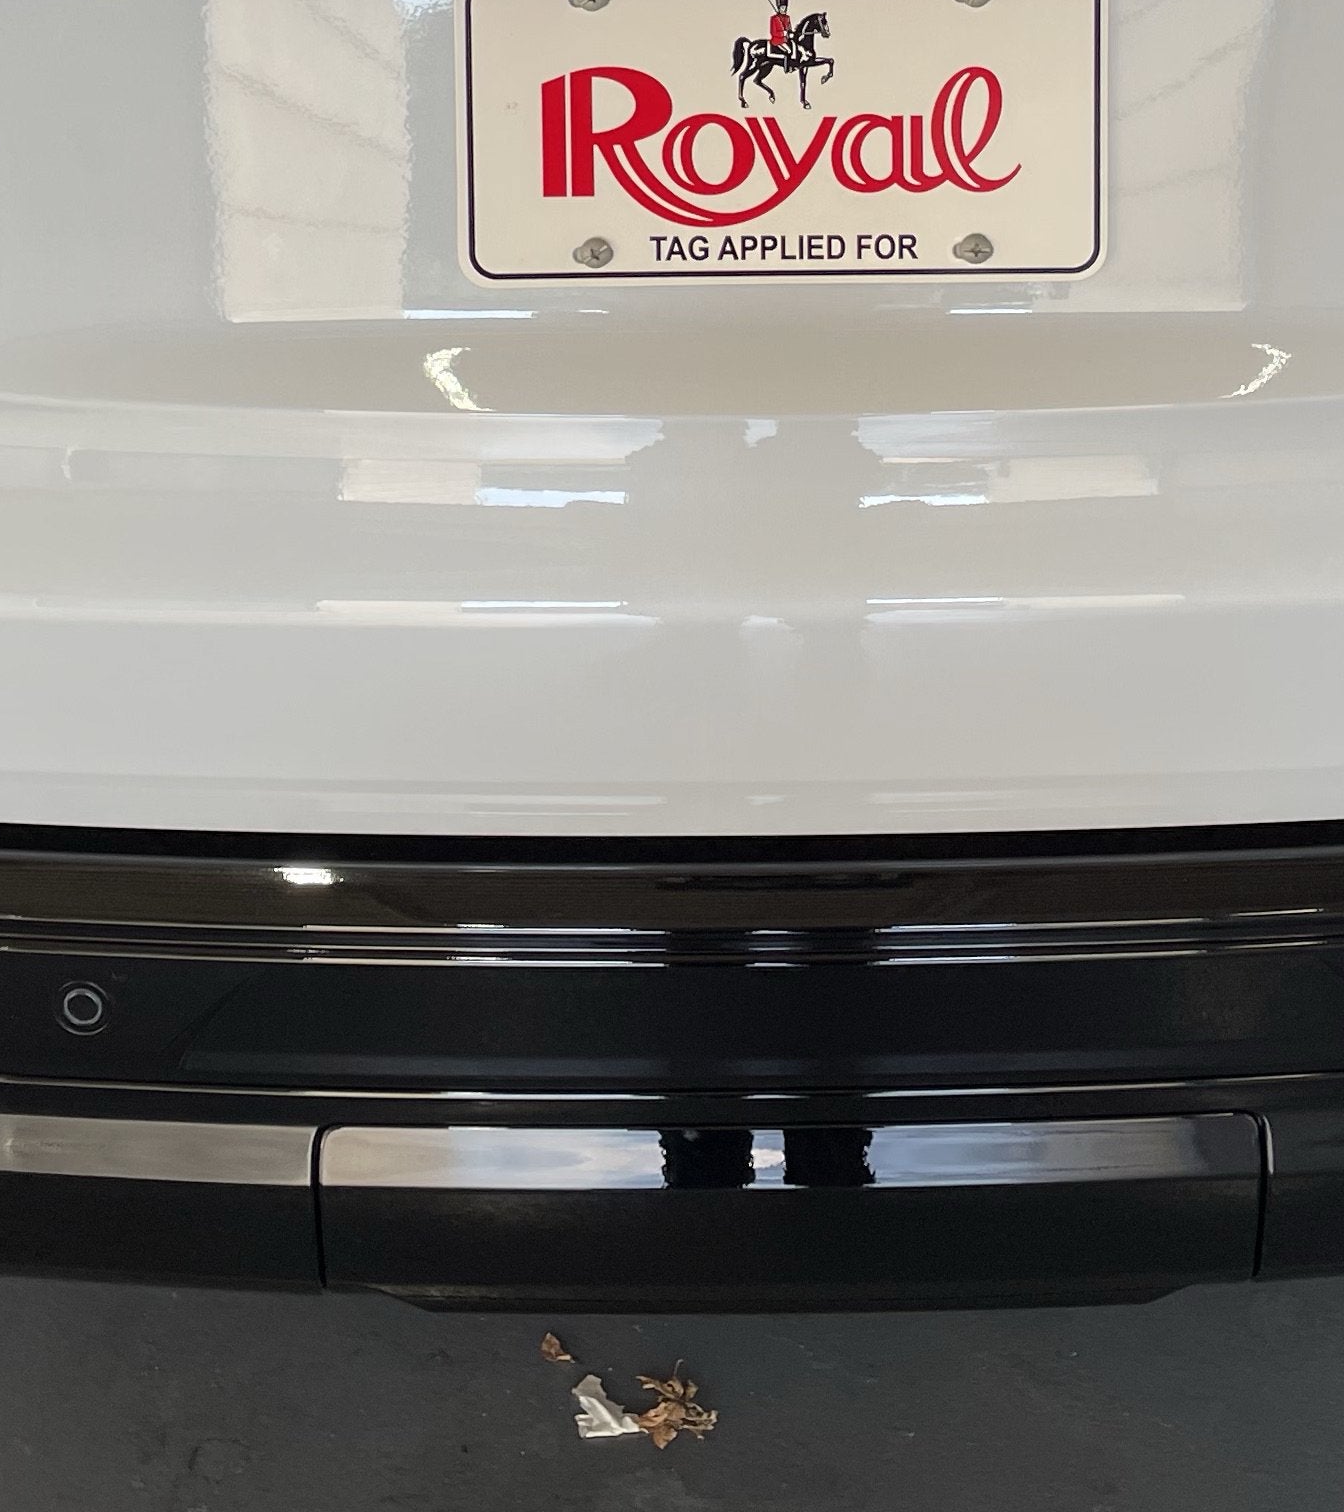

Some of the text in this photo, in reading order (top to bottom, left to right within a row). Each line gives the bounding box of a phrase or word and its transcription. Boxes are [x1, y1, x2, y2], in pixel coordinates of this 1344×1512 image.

[541, 65, 1023, 228] Royal
[649, 233, 919, 262] TAG APPLIED FOR
